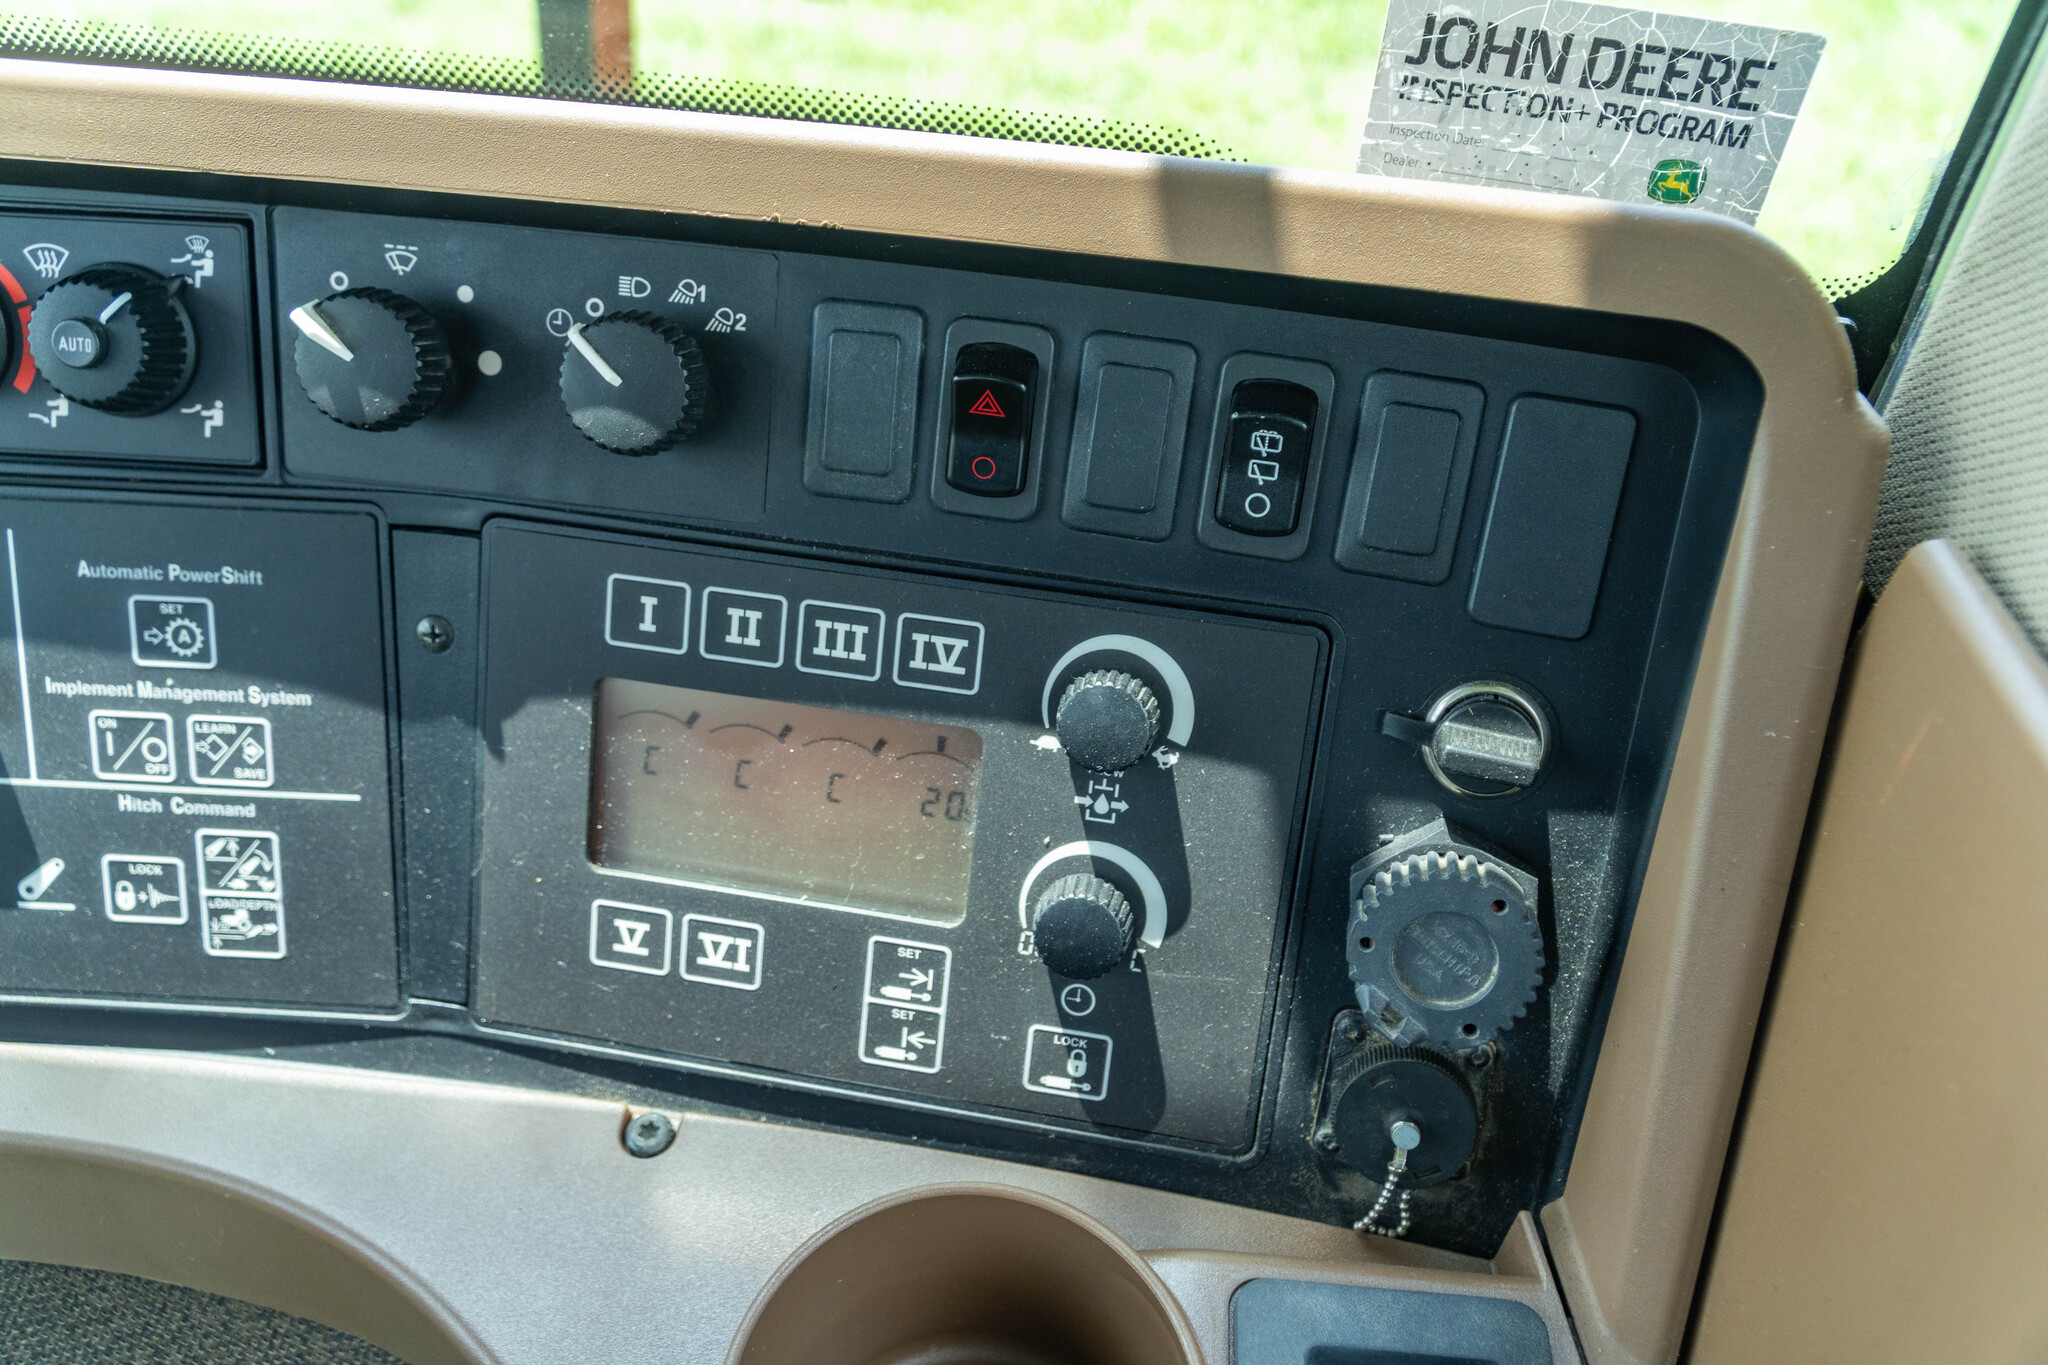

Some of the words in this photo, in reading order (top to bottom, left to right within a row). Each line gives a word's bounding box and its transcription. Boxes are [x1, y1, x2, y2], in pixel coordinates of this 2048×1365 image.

[1405, 13, 1575, 85] JOHN
[1579, 35, 1778, 112] DEERE
[1389, 124, 1449, 144] Inspection
[1596, 102, 1754, 150] PROGRAM
[697, 284, 707, 303] 1
[734, 313, 747, 332] 2
[59, 335, 92, 353] AUTO
[77, 560, 164, 582] Automatic
[168, 563, 263, 586] PowerShift
[159, 603, 183, 615] SET
[725, 606, 762, 647] II
[177, 629, 191, 645] A
[813, 619, 869, 661] III
[909, 632, 969, 676] IV
[45, 676, 134, 698] Implement
[136, 680, 245, 705] Management
[247, 685, 313, 708] System
[97, 717, 117, 729] ON
[194, 722, 236, 735] LEARN
[144, 763, 169, 775] OFF
[233, 767, 267, 780] SAVE
[118, 794, 162, 813] Hitch
[170, 797, 256, 818] Command
[128, 863, 163, 876] LOCK
[611, 918, 651, 957] V
[696, 931, 753, 973] VI
[897, 947, 921, 960] SET
[891, 1008, 915, 1021] SET
[1053, 1034, 1087, 1049] LOCK
